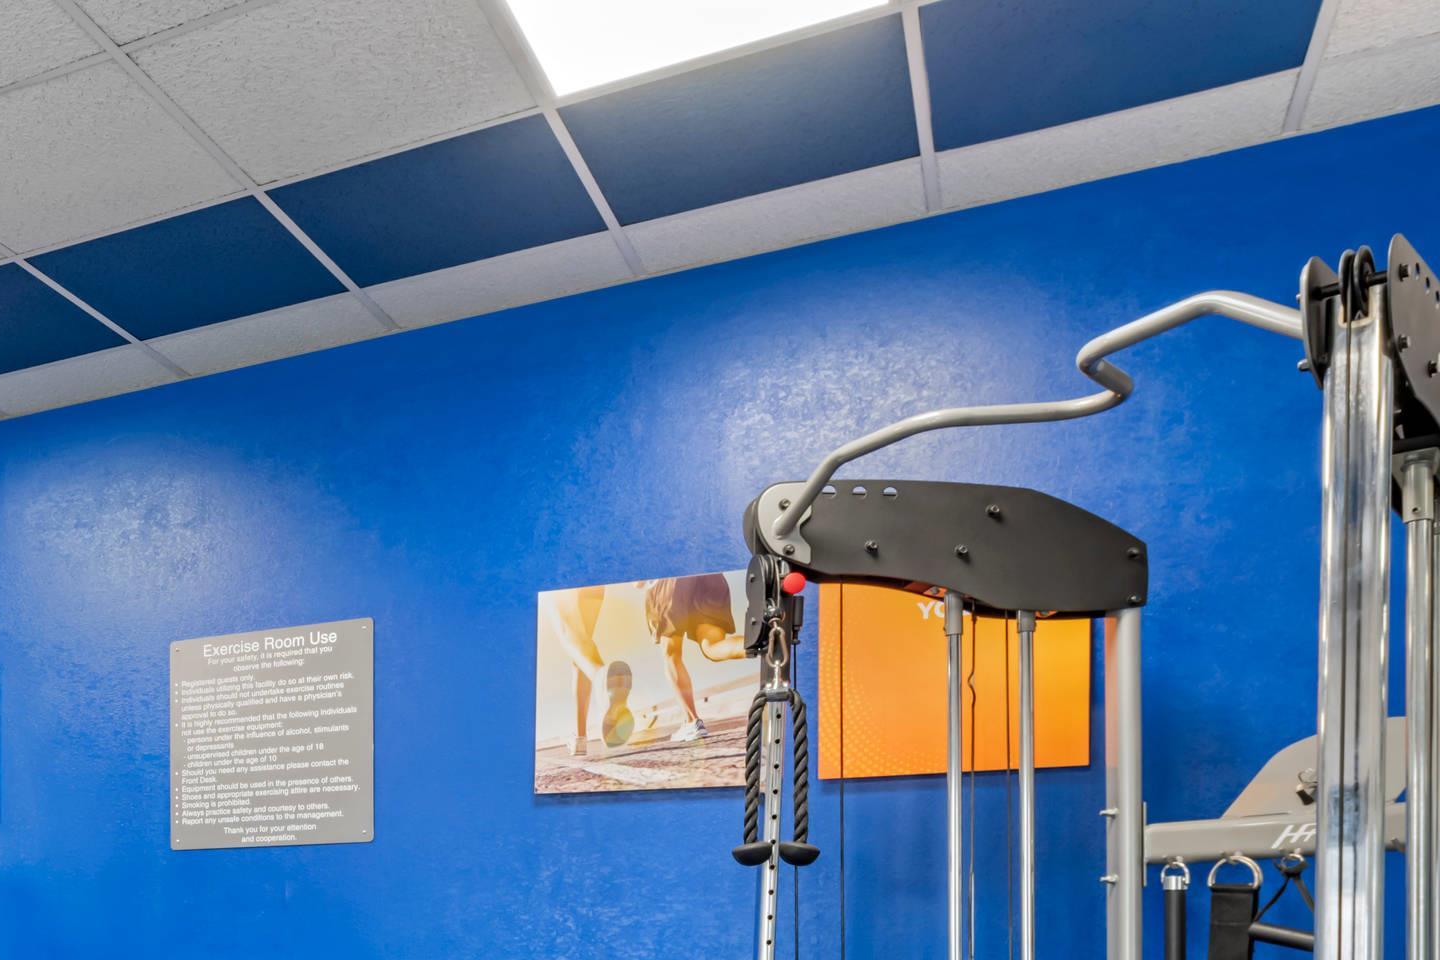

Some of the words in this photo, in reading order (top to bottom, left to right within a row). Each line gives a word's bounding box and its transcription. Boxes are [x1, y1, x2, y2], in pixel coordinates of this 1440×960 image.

[203, 641, 260, 656] Exercise
[264, 636, 305, 650] Room
[310, 632, 337, 645] Use
[220, 657, 235, 665] your
[273, 649, 303, 658] required
[181, 678, 216, 688] Registered
[217, 676, 238, 685] guests
[181, 687, 215, 695] Individuals
[216, 684, 241, 692] utilizing
[181, 695, 215, 703] Individuals
[251, 689, 284, 697] undertake
[286, 685, 314, 693] exercise
[203, 702, 234, 711] physically
[236, 699, 264, 707] qualified
[194, 720, 213, 728] highly
[214, 716, 261, 725] recommended
[320, 707, 357, 715] individuals
[187, 737, 213, 745] persons
[314, 725, 349, 733] stimulants
[195, 743, 234, 752] depressants
[258, 747, 278, 755] under
[249, 764, 285, 772] assistance
[286, 762, 309, 770] please
[182, 785, 216, 793] Equipment
[217, 791, 254, 799] appropriate
[296, 811, 344, 819] management.
[255, 834, 297, 842] cooperation.
